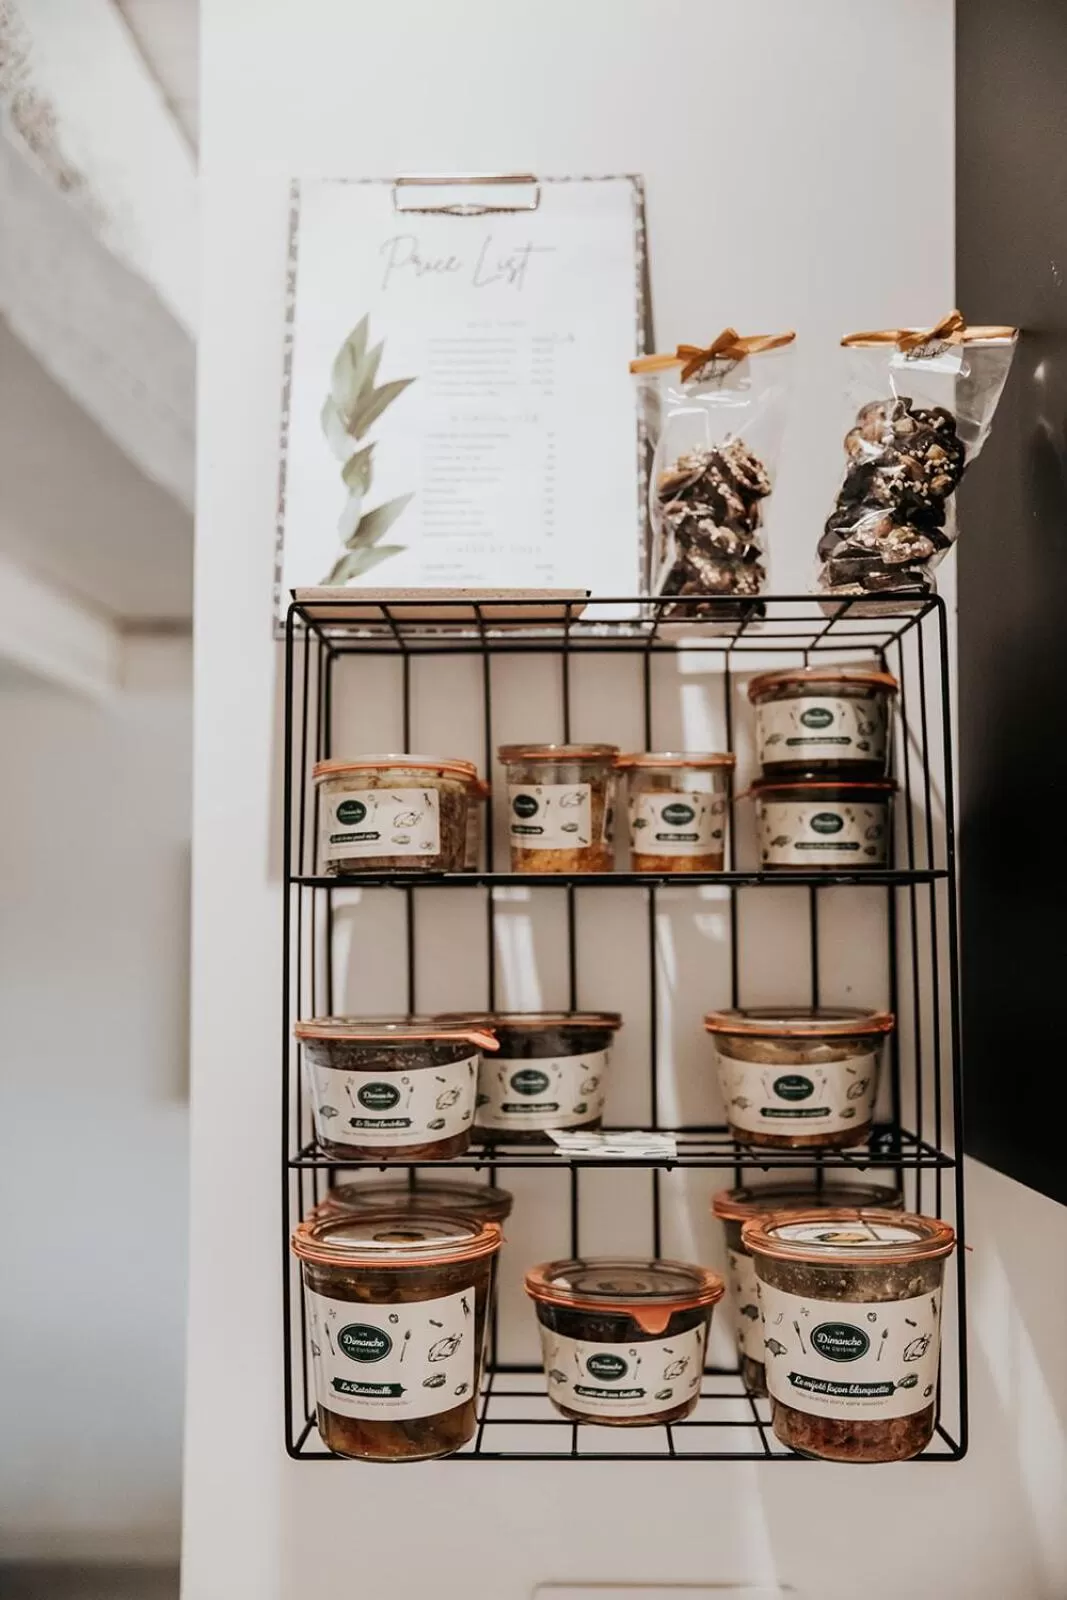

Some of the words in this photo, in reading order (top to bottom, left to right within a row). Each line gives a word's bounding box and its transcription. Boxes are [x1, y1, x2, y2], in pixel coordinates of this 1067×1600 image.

[471, 233, 557, 292] List
[344, 1334, 384, 1347] Dimanche
[817, 1333, 862, 1345] Dimanche
[849, 1385, 889, 1394] blanquette
